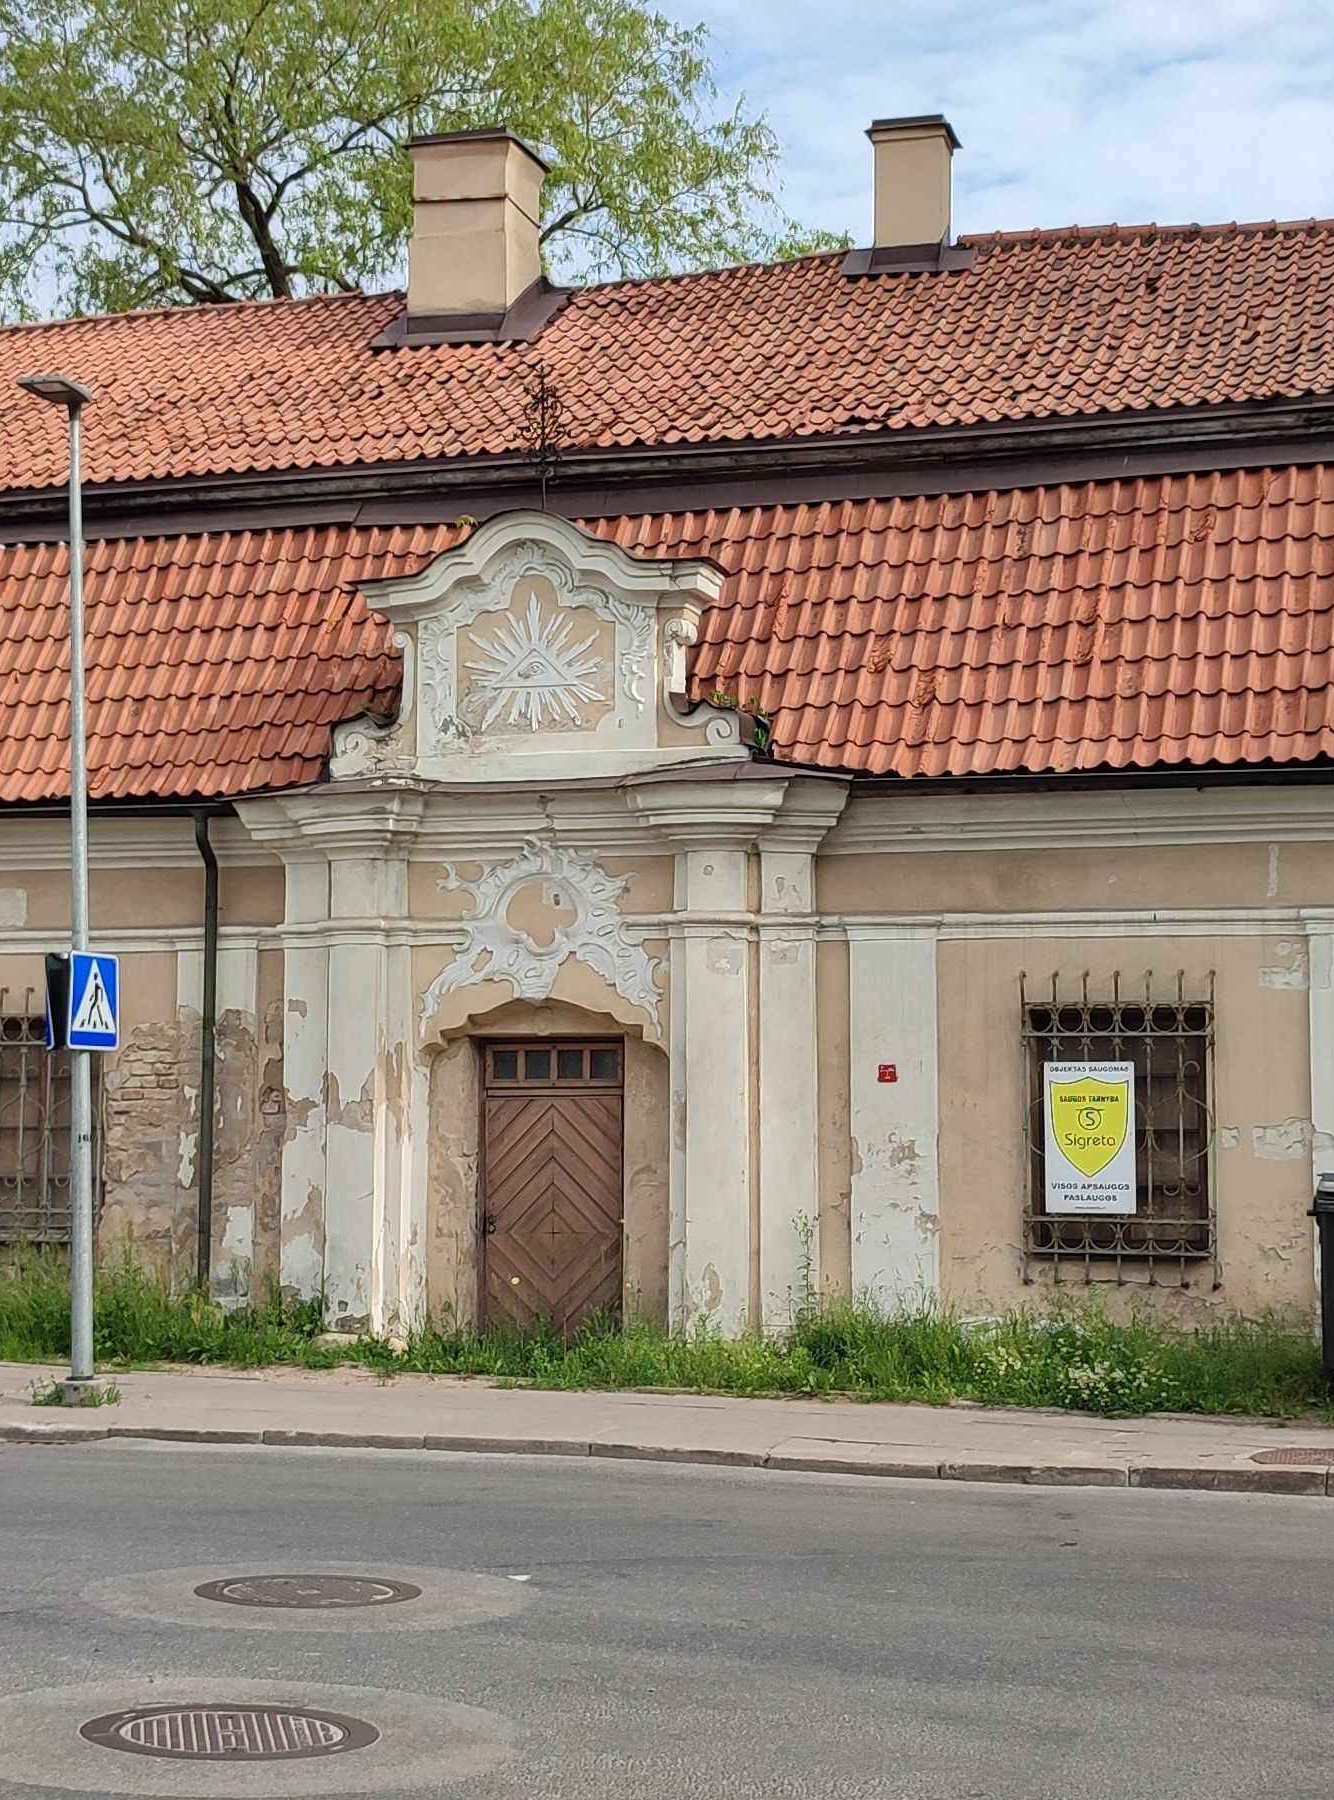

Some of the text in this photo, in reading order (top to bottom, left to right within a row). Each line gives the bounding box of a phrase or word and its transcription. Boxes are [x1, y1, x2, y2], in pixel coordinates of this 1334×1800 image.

[1051, 1182, 1130, 1190] VISOS APSAUGOS
[1063, 1194, 1118, 1202] PASLAUGOS
